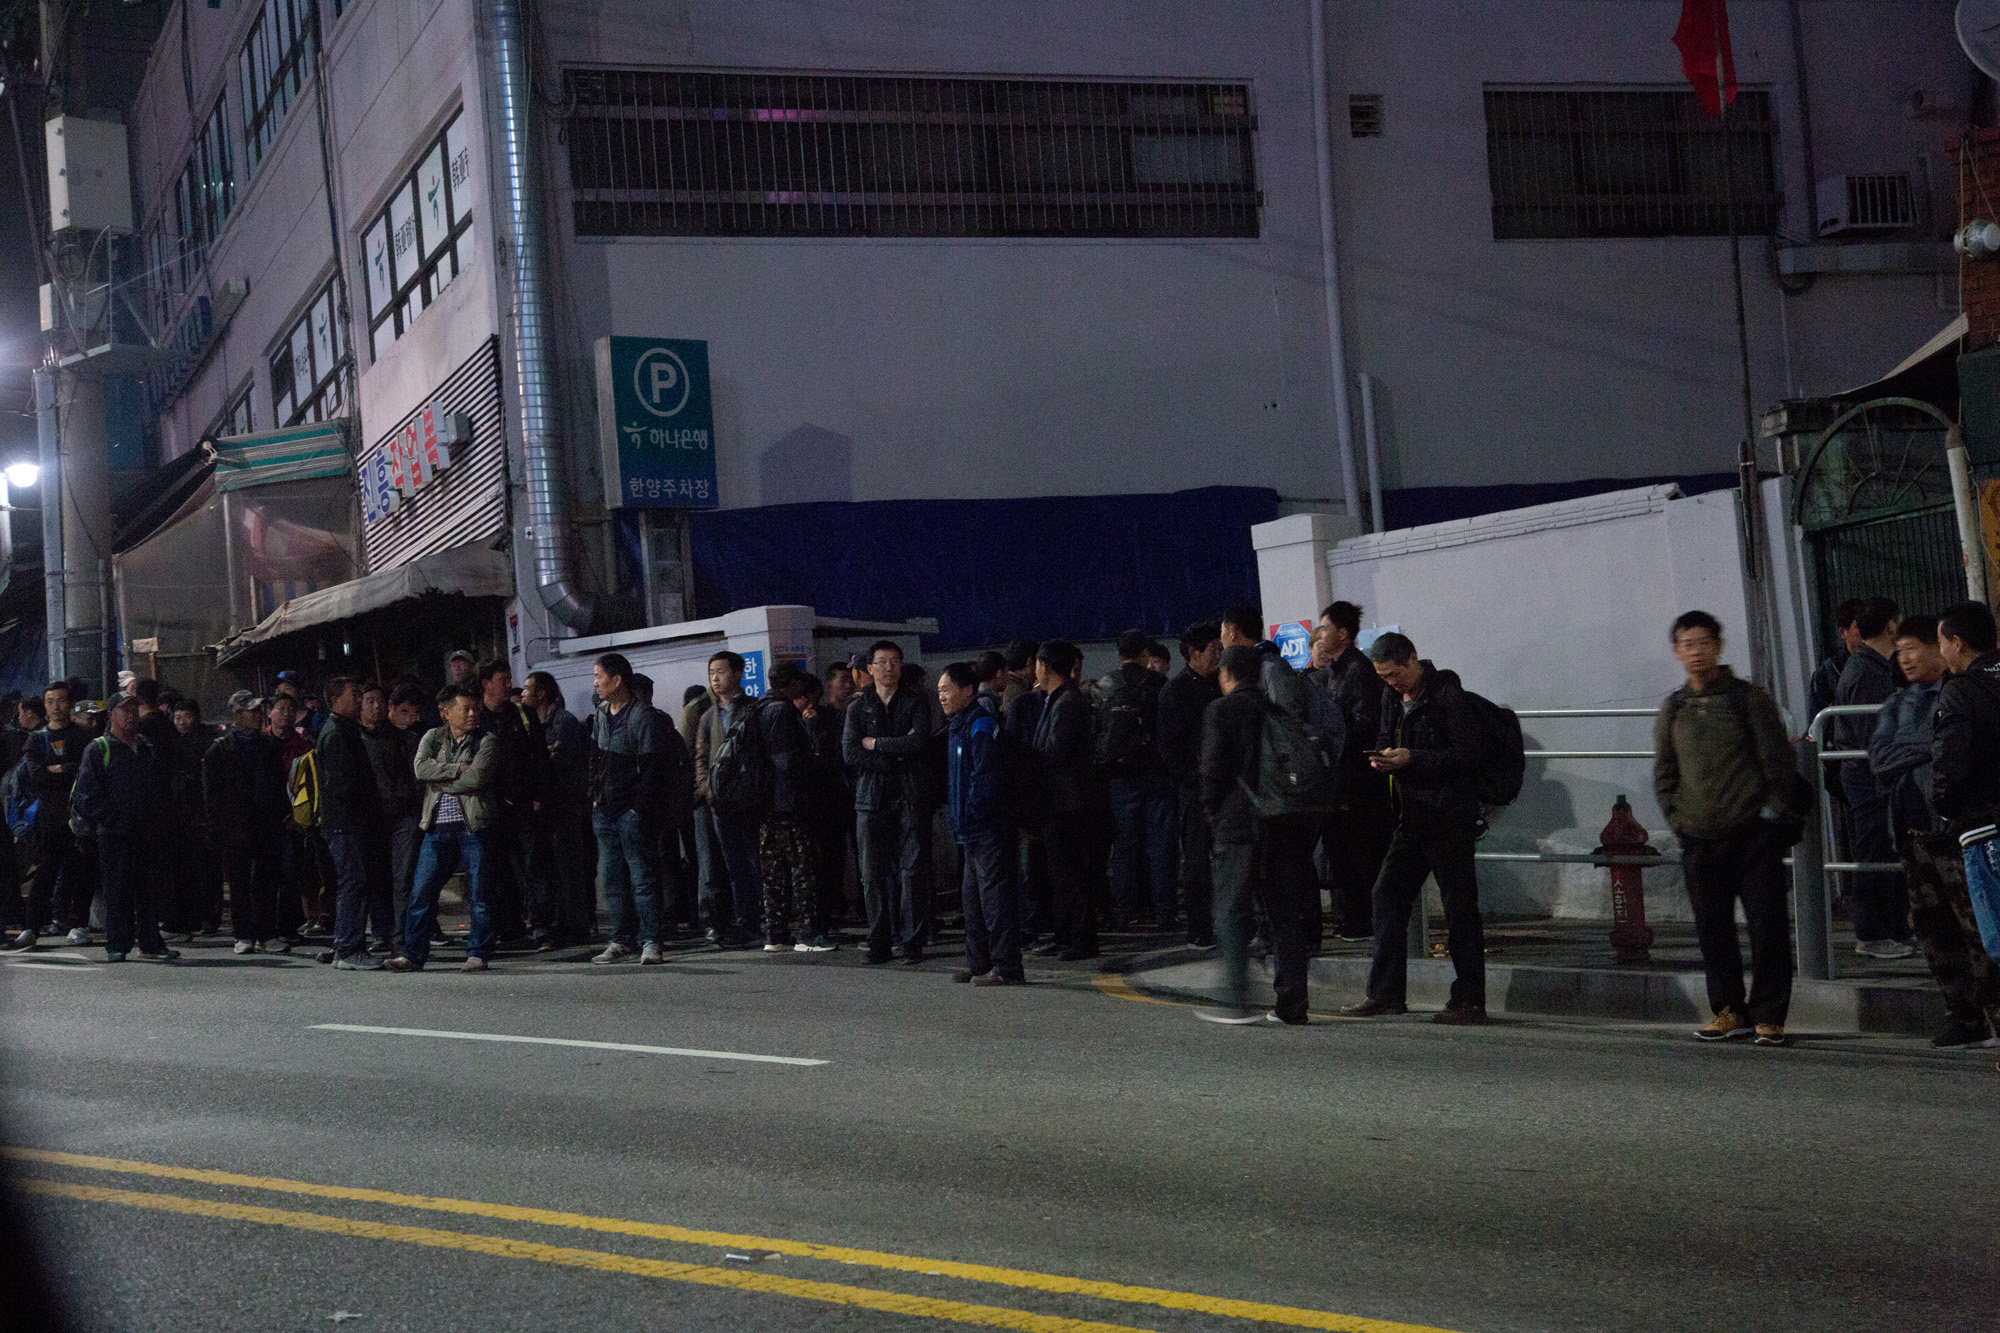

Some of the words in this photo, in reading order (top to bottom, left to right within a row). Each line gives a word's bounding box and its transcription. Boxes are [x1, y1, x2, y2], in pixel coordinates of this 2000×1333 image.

[650, 362, 677, 404] P
[650, 428, 709, 451] 하나은행
[629, 476, 710, 500] 한양주차장
[1280, 637, 1306, 658] ADT
